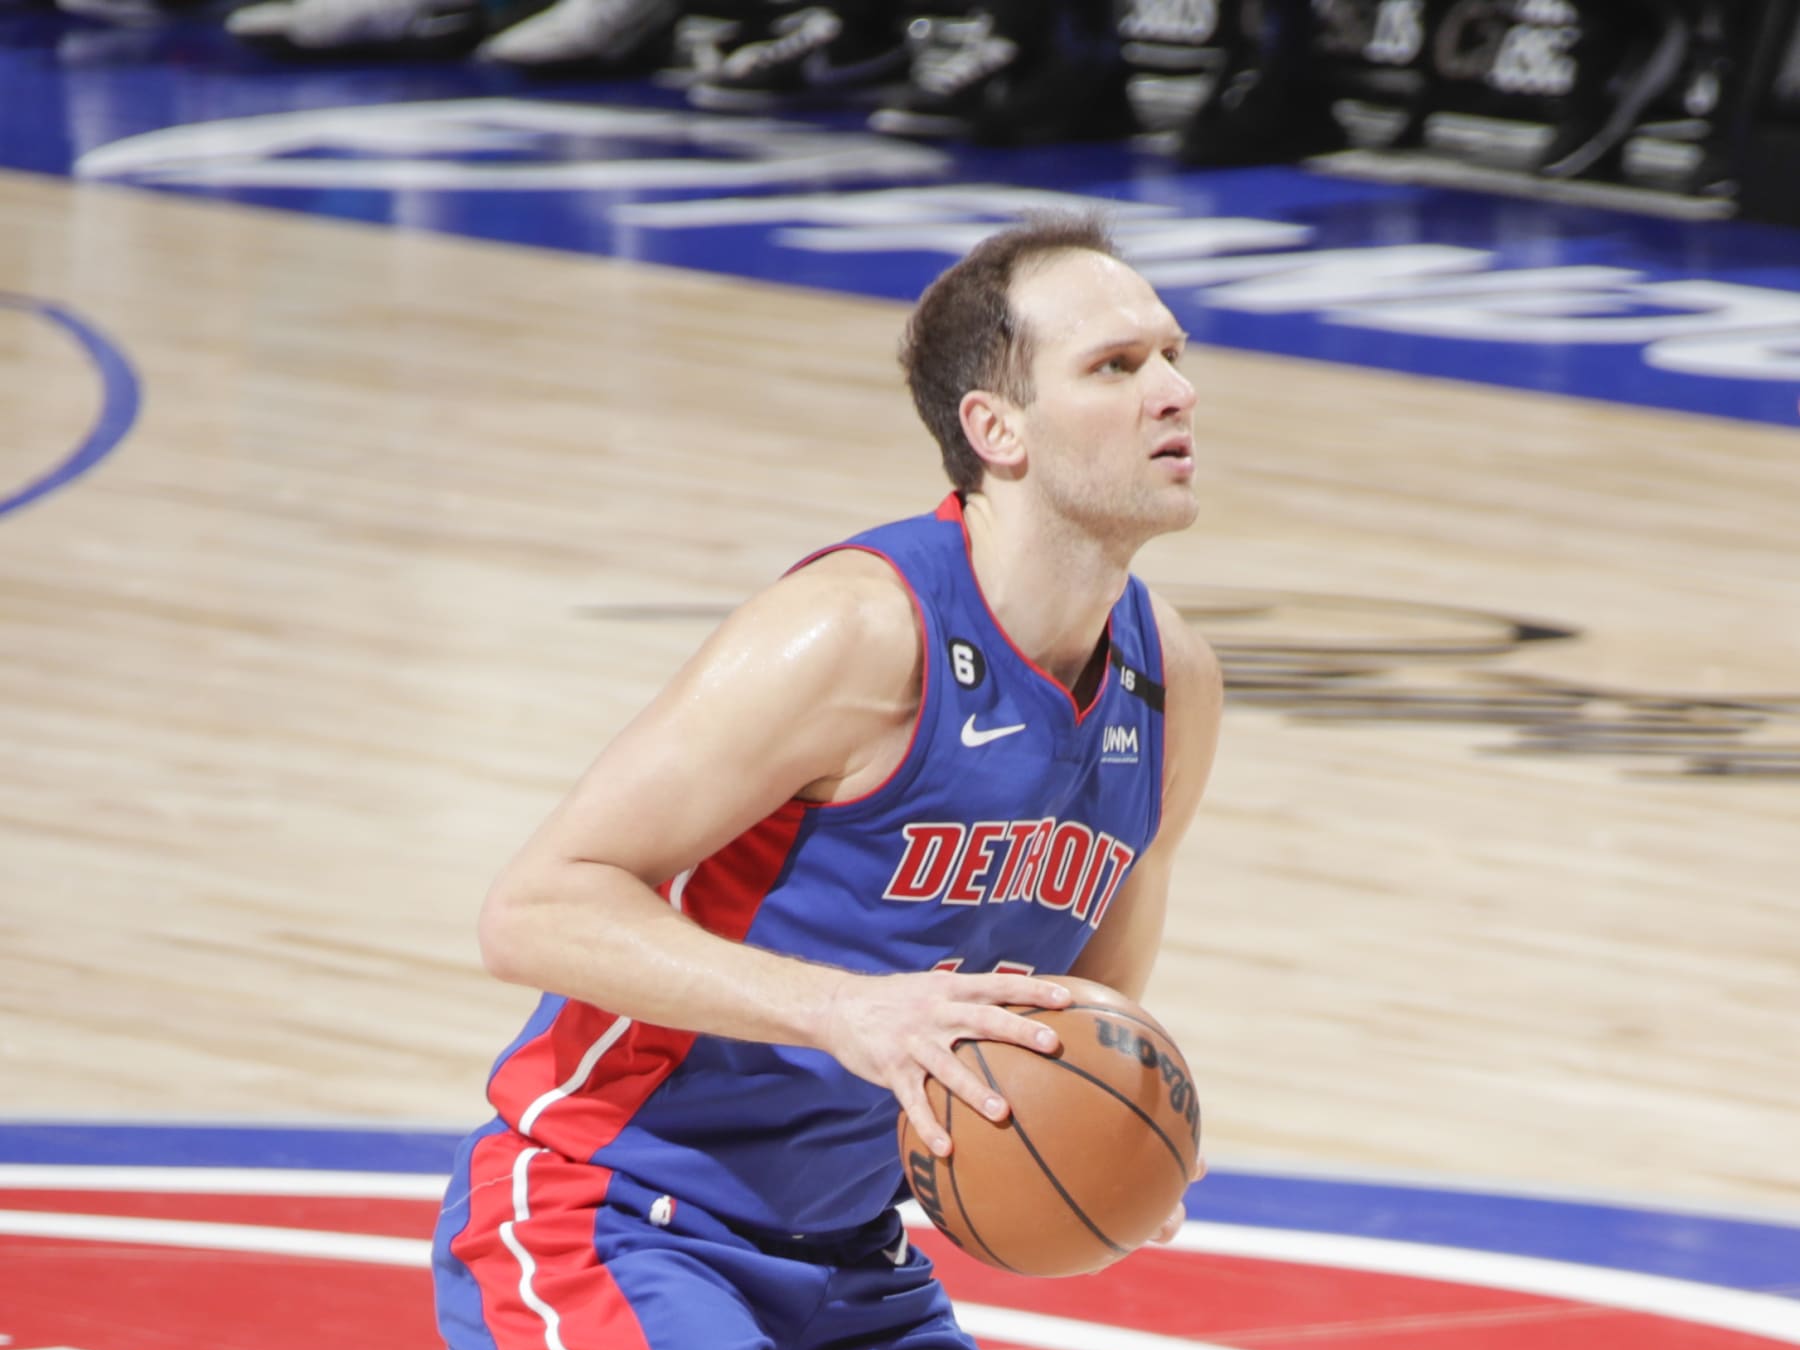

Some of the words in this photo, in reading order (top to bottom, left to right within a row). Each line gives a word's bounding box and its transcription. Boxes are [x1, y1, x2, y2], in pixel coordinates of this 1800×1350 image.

[952, 643, 975, 685] 6
[1102, 725, 1138, 753] UWM
[882, 816, 1135, 930] DETROIT
[1094, 1017, 1199, 1146] ilson
